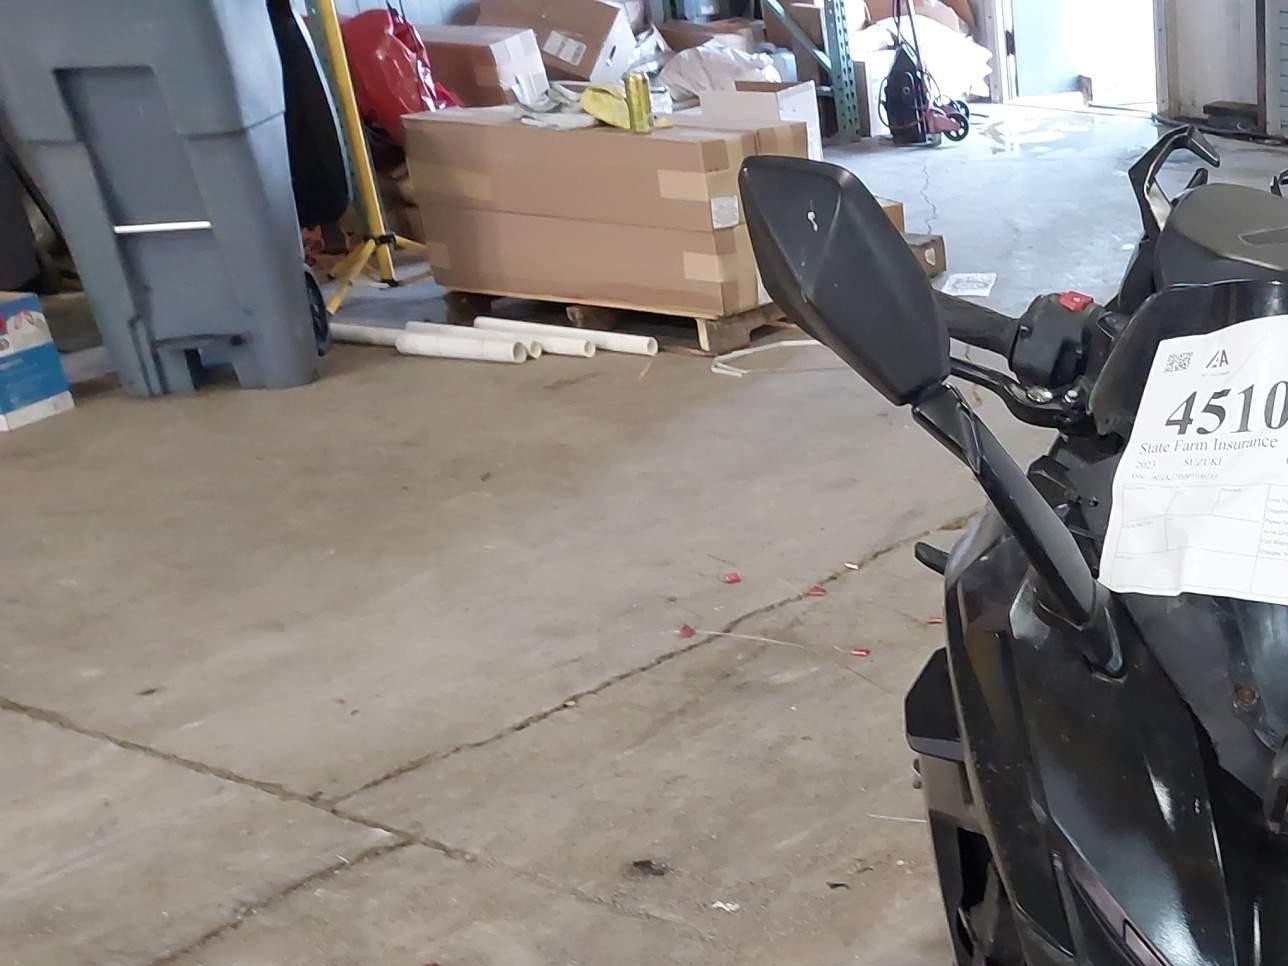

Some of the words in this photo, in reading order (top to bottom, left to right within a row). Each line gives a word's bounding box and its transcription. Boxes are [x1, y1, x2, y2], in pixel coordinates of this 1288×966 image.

[1138, 442, 1171, 456] State
[1174, 439, 1208, 452] Farm
[1213, 436, 1279, 451] Insurance
[1183, 456, 1223, 468] SUZUKI
